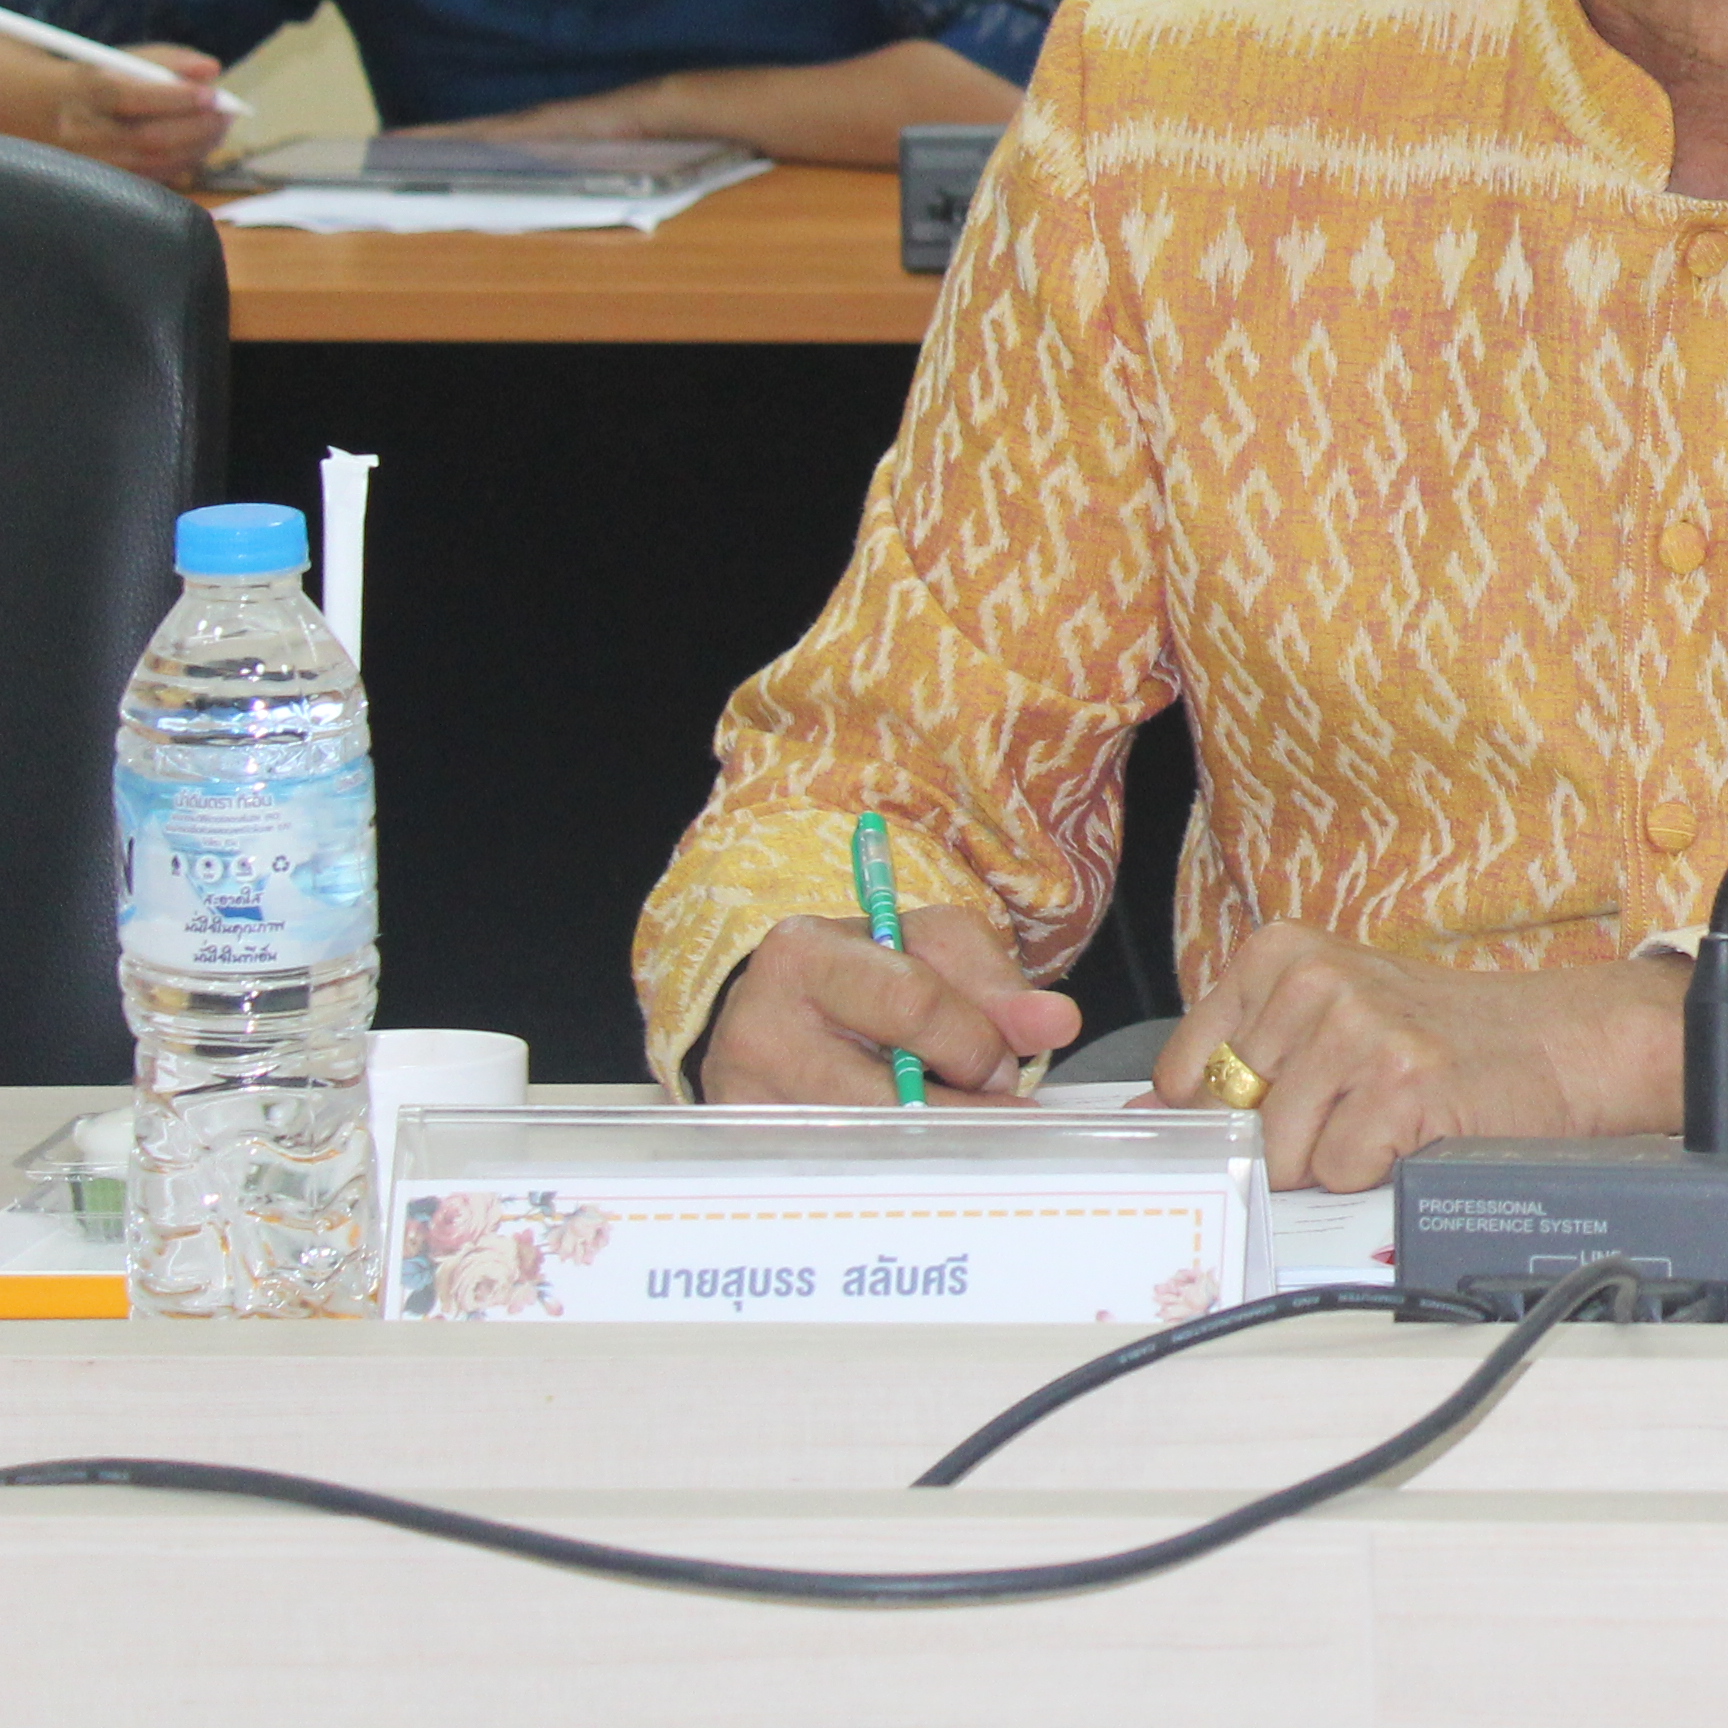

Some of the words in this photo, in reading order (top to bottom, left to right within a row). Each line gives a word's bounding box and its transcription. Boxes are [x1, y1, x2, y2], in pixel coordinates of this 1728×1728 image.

[203, 886, 264, 905] สะอาดใส
[1419, 1199, 1547, 1216] PROFESSIONAL
[1419, 1217, 1534, 1233] CONFERENCE
[1540, 1219, 1608, 1235] SYSTEM
[646, 1265, 817, 1313] นายสุบรร
[842, 1253, 969, 1297] สลับศรี
